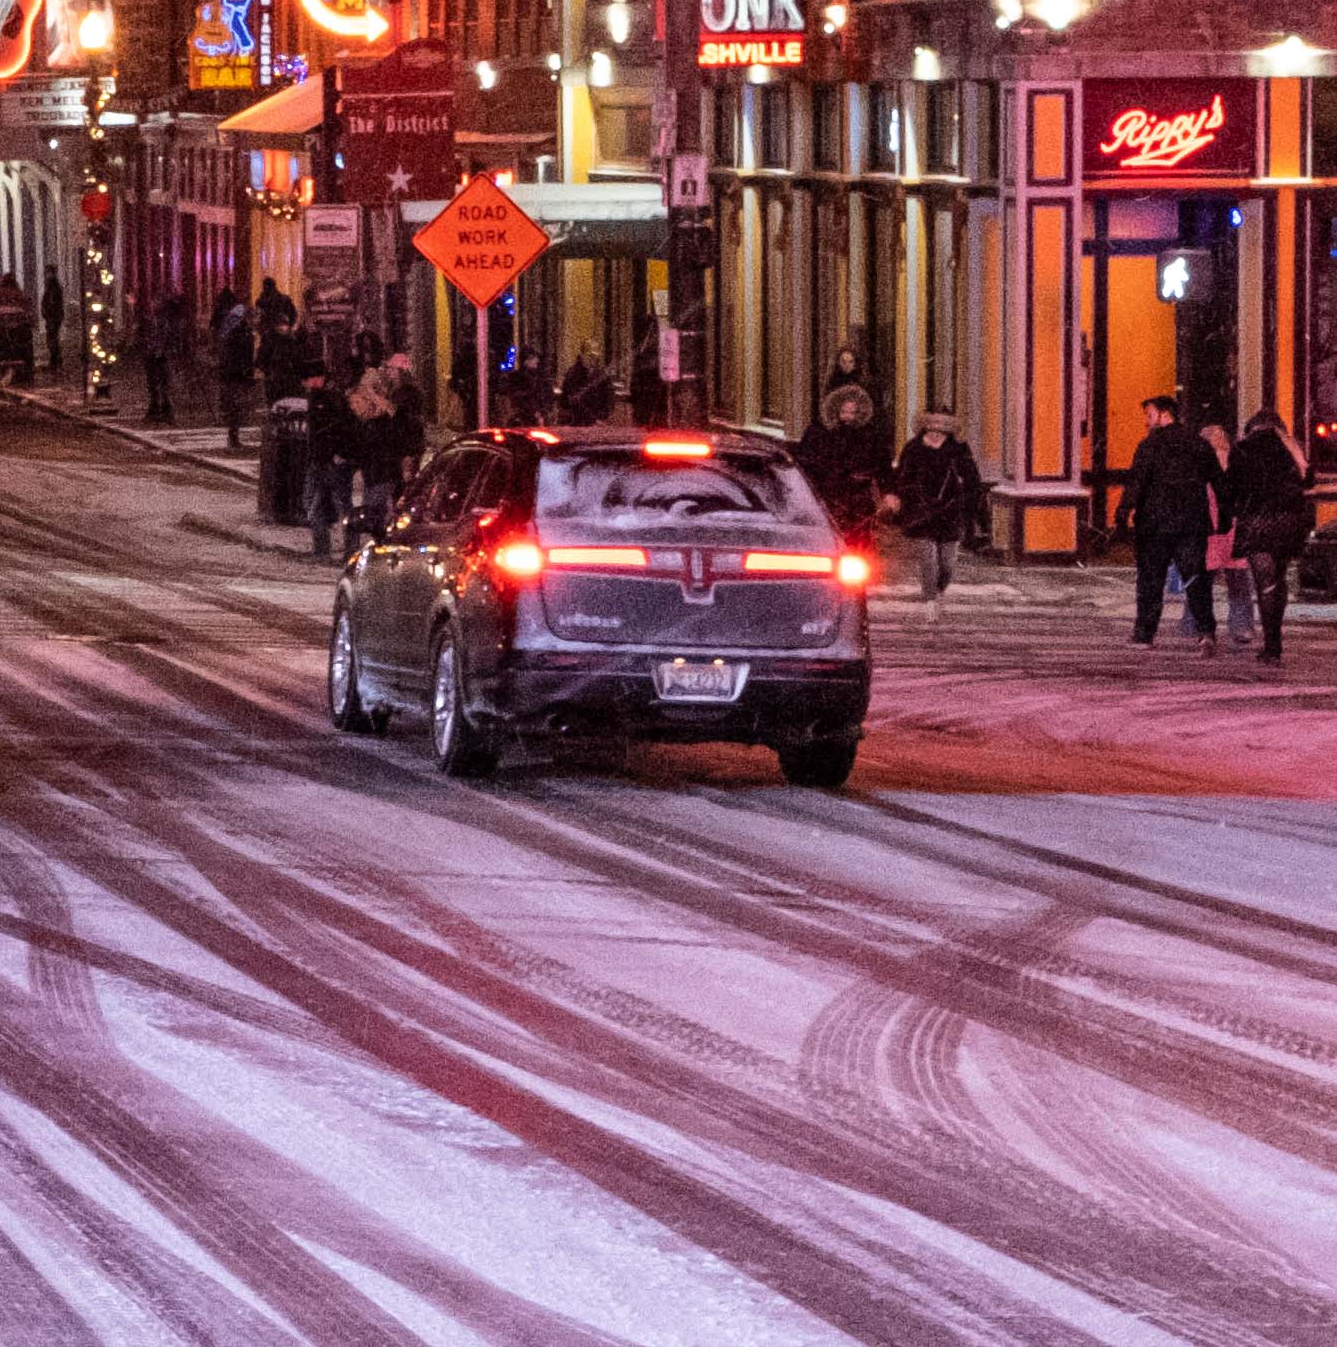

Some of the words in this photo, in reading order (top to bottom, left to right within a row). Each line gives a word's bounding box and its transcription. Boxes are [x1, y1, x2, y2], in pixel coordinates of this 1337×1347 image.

[349, 116, 375, 133] The
[386, 114, 448, 134] District
[1101, 95, 1224, 159] Rippy's
[457, 205, 507, 222] ROAD
[457, 229, 508, 246] WORK
[454, 253, 515, 270] AHEAD
